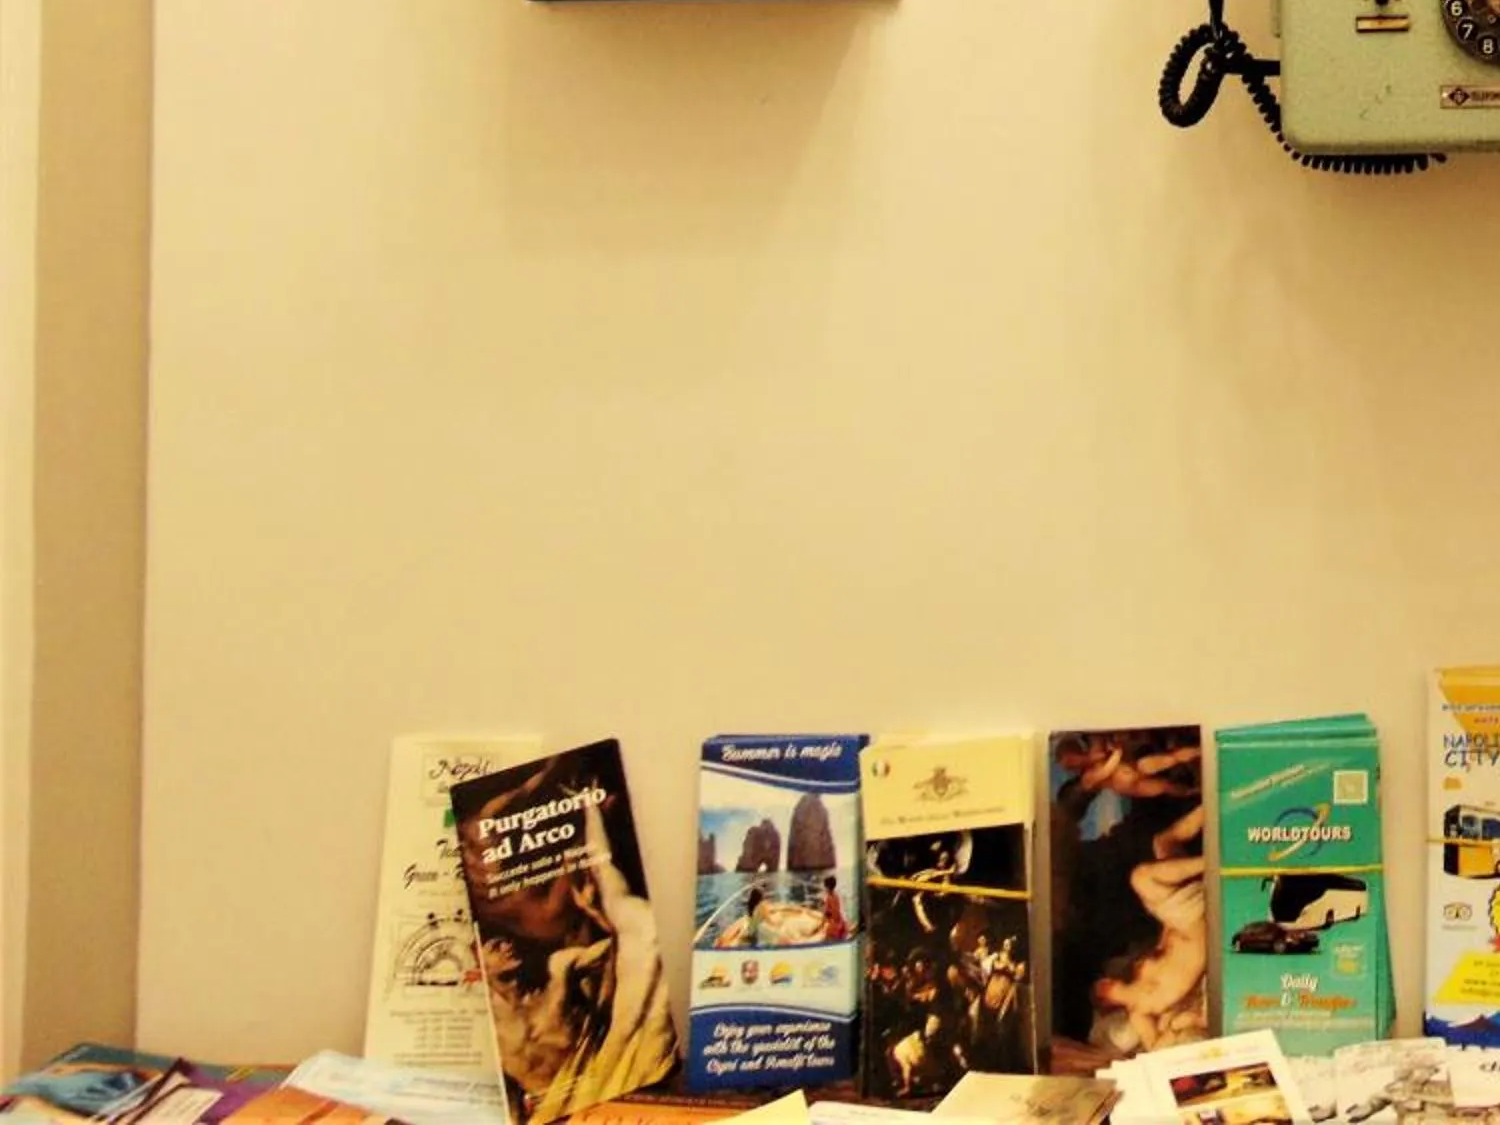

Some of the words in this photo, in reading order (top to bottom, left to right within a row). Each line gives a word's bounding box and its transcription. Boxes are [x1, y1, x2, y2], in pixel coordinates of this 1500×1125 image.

[1451, 1, 1463, 16] 6
[1462, 24, 1473, 39] 7
[1482, 39, 1494, 53] 8
[722, 743, 780, 761] Summer
[784, 742, 797, 759] is
[800, 741, 842, 761] magic
[479, 787, 607, 840] Purgatorio
[482, 839, 513, 864] ad
[519, 823, 575, 858] Arco
